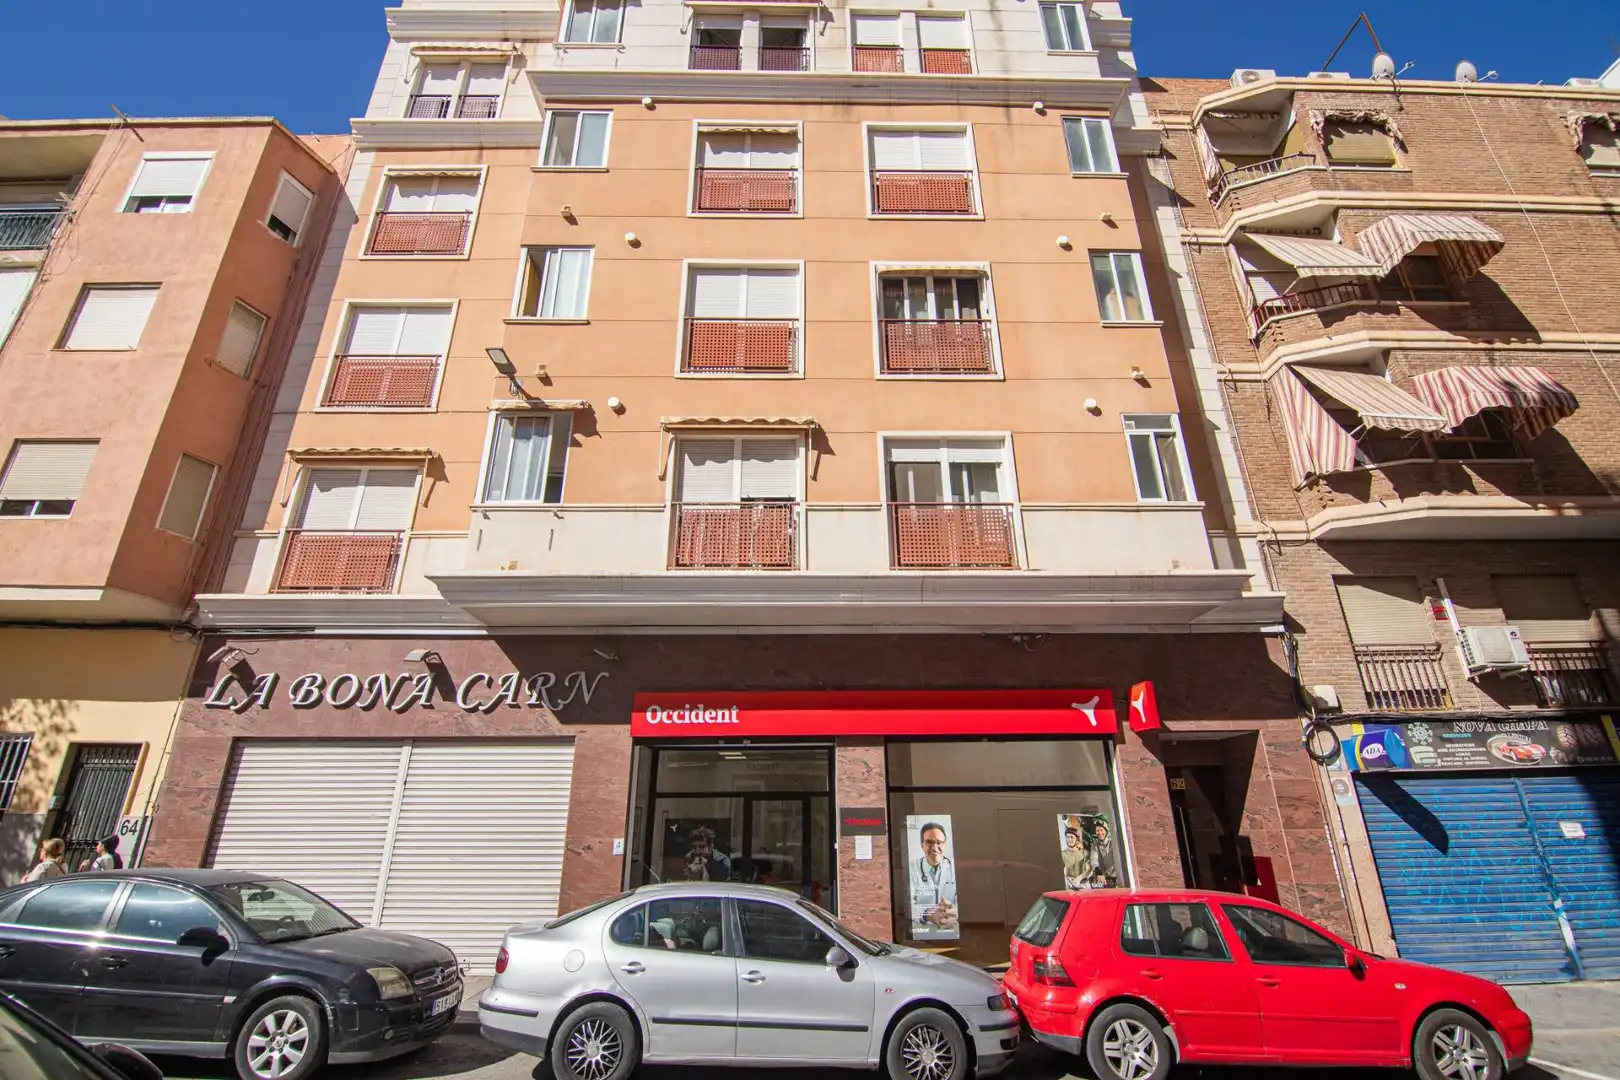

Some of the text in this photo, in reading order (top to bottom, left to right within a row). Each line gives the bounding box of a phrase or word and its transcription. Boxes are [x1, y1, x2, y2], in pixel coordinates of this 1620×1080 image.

[203, 670, 610, 714] LA BONA CARN
[646, 703, 740, 724] Occident
[1453, 720, 1550, 732] NOVA CHAPA
[120, 819, 139, 836] 64
